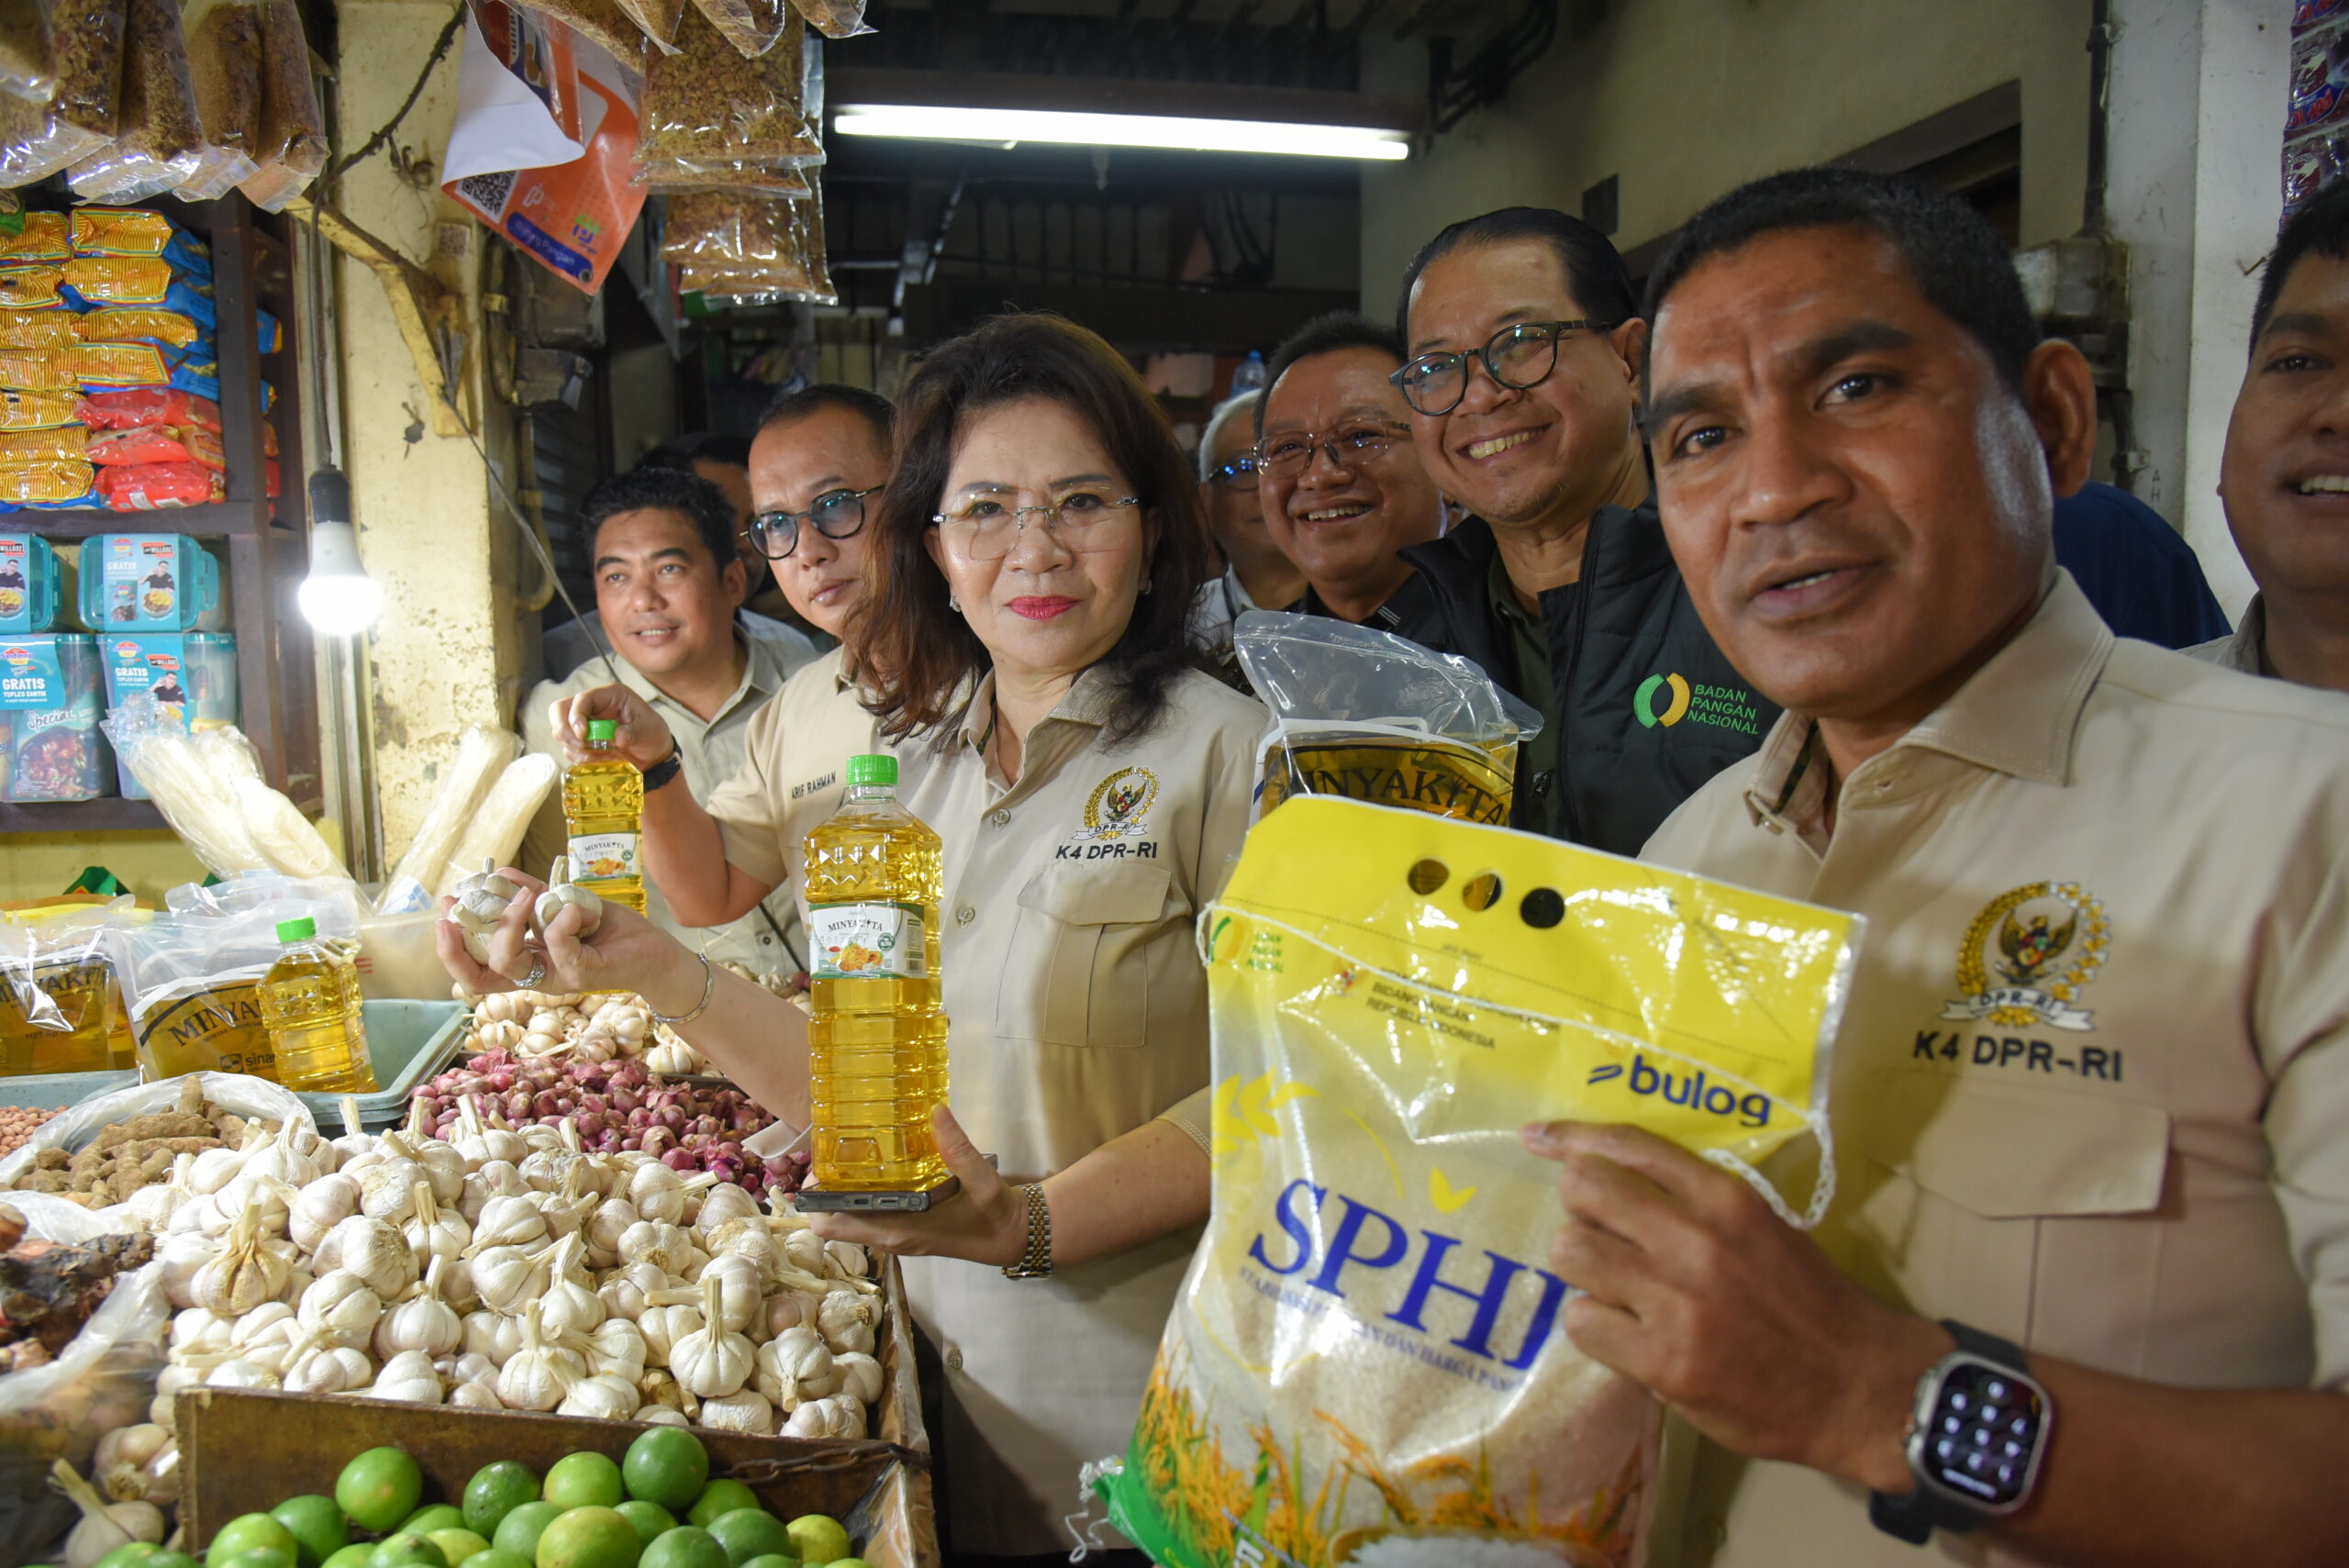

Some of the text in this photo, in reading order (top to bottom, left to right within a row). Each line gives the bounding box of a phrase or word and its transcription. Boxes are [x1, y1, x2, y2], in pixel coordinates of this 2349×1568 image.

[2, 678, 46, 691] GRATIS
[1695, 684, 1746, 703] BADAN
[27, 708, 77, 733] Special
[1690, 696, 1757, 720] PANGAN
[1687, 709, 1760, 735] NASIONAL
[791, 770, 837, 800] ARIF RAHMAN
[1055, 841, 1158, 860] K4 DPR-RI
[1913, 1030, 2124, 1083] K4 DPR-RI
[1628, 1053, 1772, 1129] bulog
